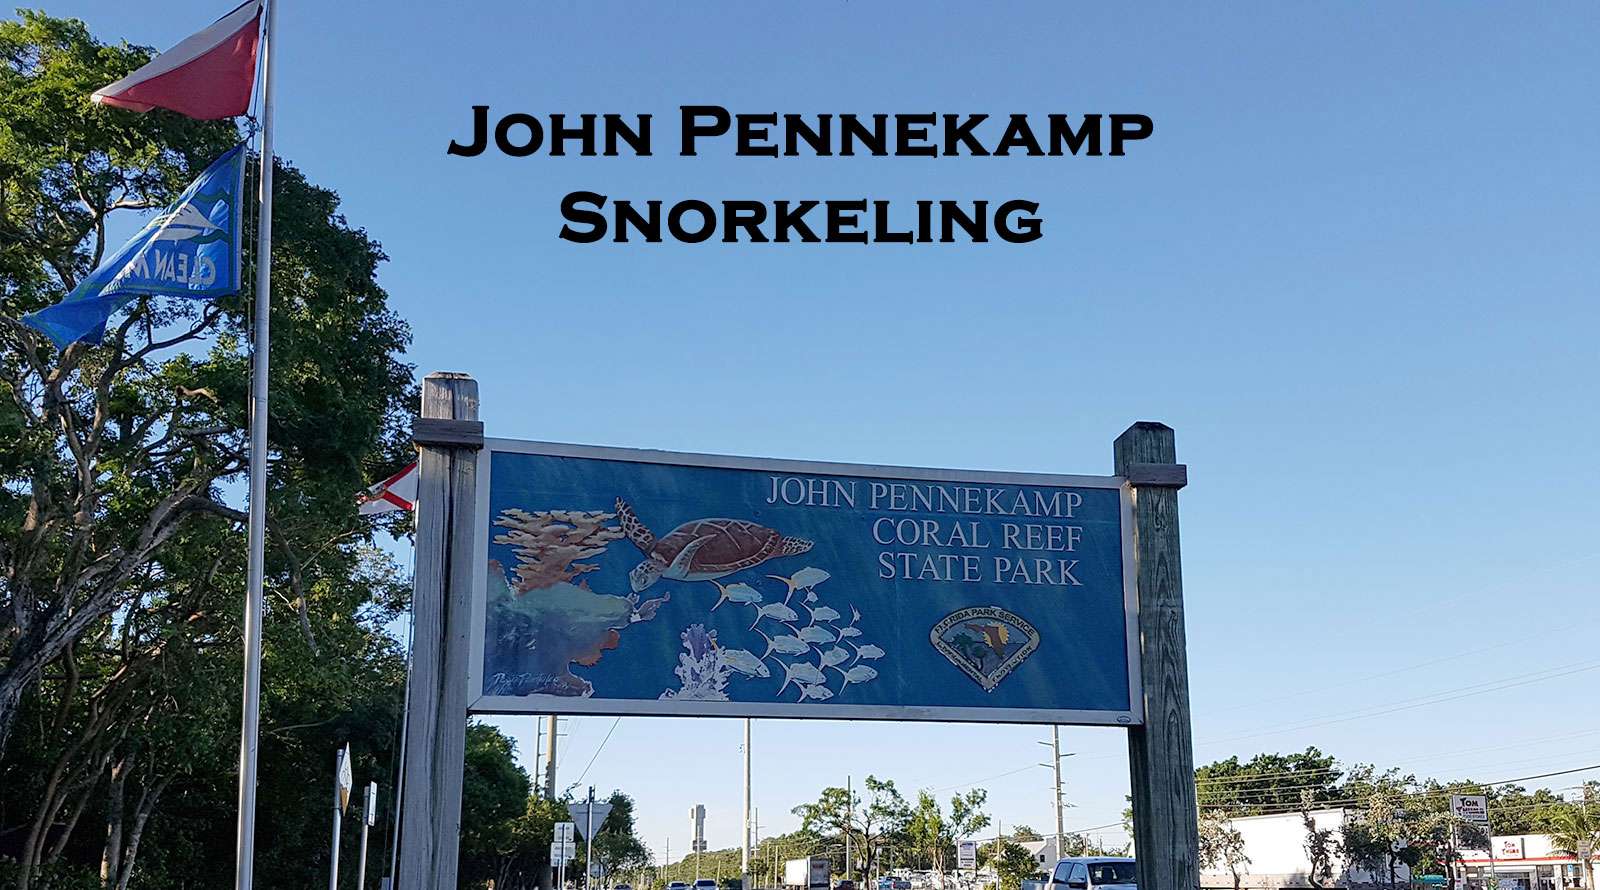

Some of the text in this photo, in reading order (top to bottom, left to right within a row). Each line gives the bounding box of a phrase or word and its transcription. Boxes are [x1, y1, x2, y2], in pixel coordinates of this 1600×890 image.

[766, 476, 1083, 519] JOHN PENNEKAMP
[872, 517, 1083, 553] CORAL REEF
[878, 552, 1083, 587] STATE PARK
[935, 608, 1036, 638] FLORIDA PARK SERVICE
